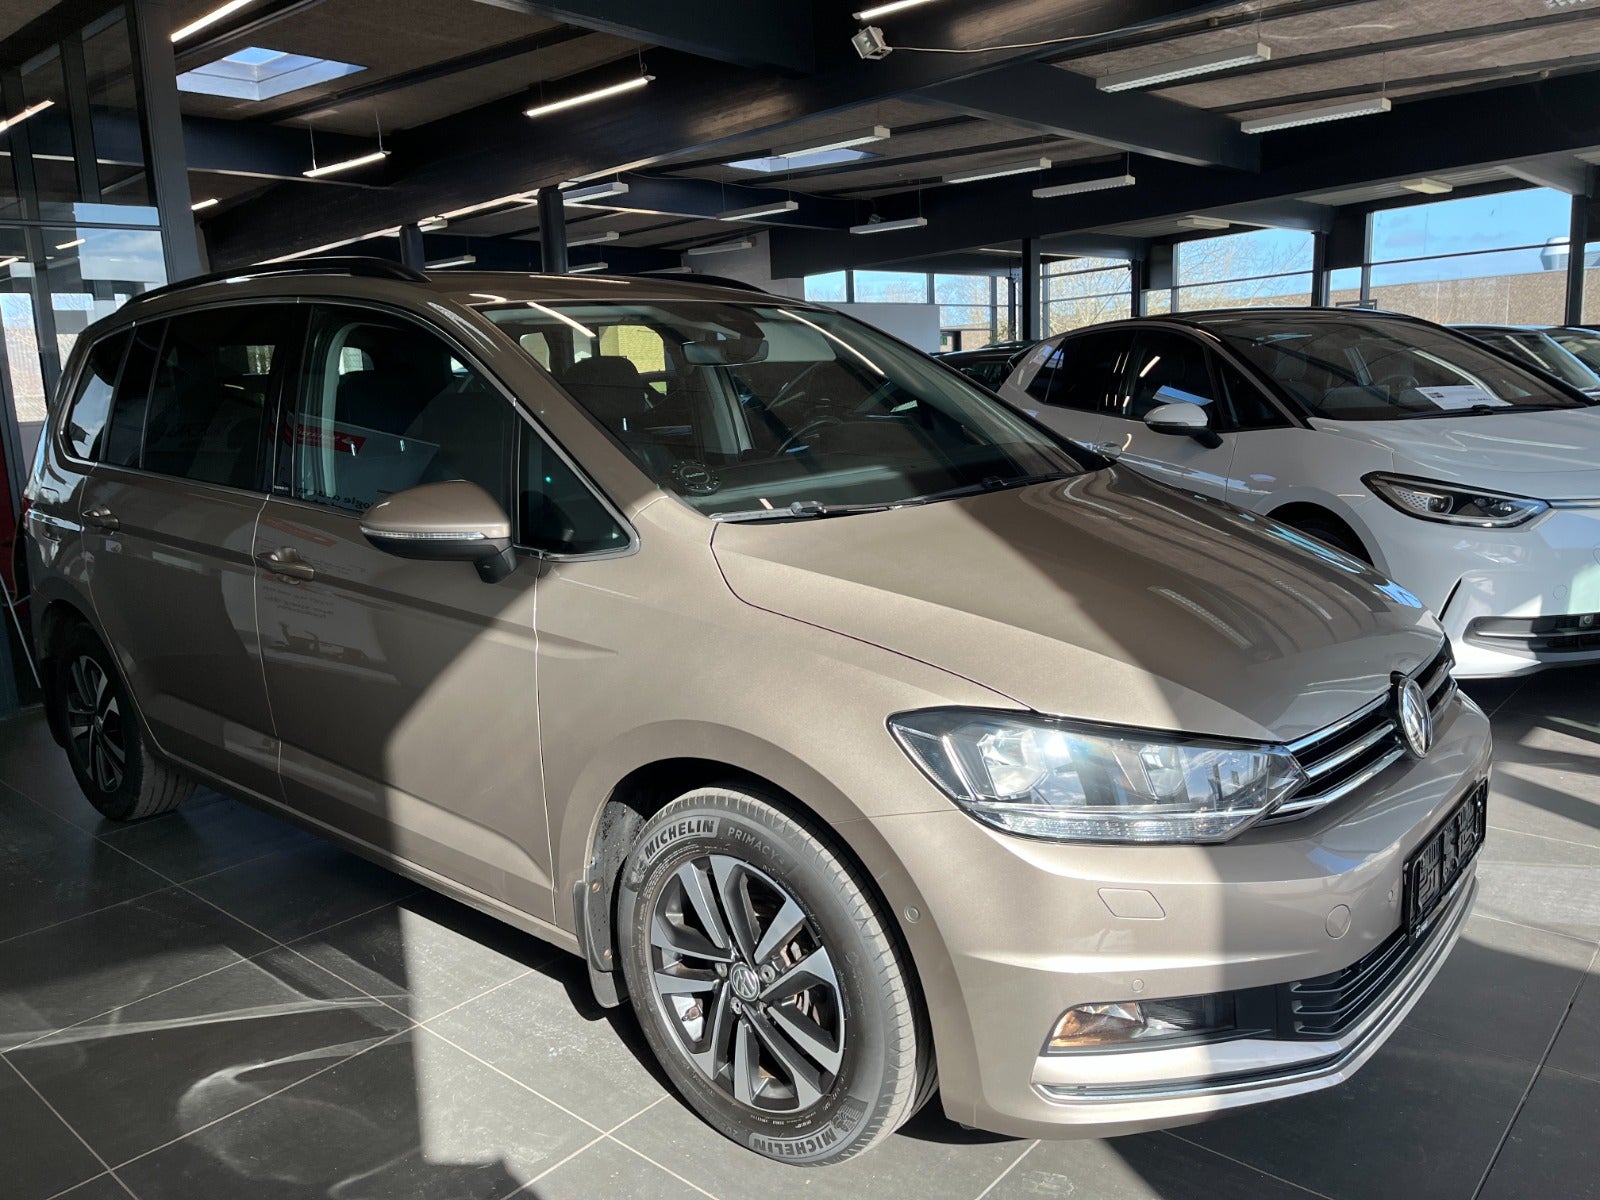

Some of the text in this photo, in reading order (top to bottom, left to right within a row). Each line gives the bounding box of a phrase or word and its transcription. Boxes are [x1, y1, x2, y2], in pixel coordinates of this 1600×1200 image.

[645, 819, 714, 859] MICHELIN
[728, 826, 777, 859] PRIMACY
[753, 1126, 835, 1156] MICHELIN
